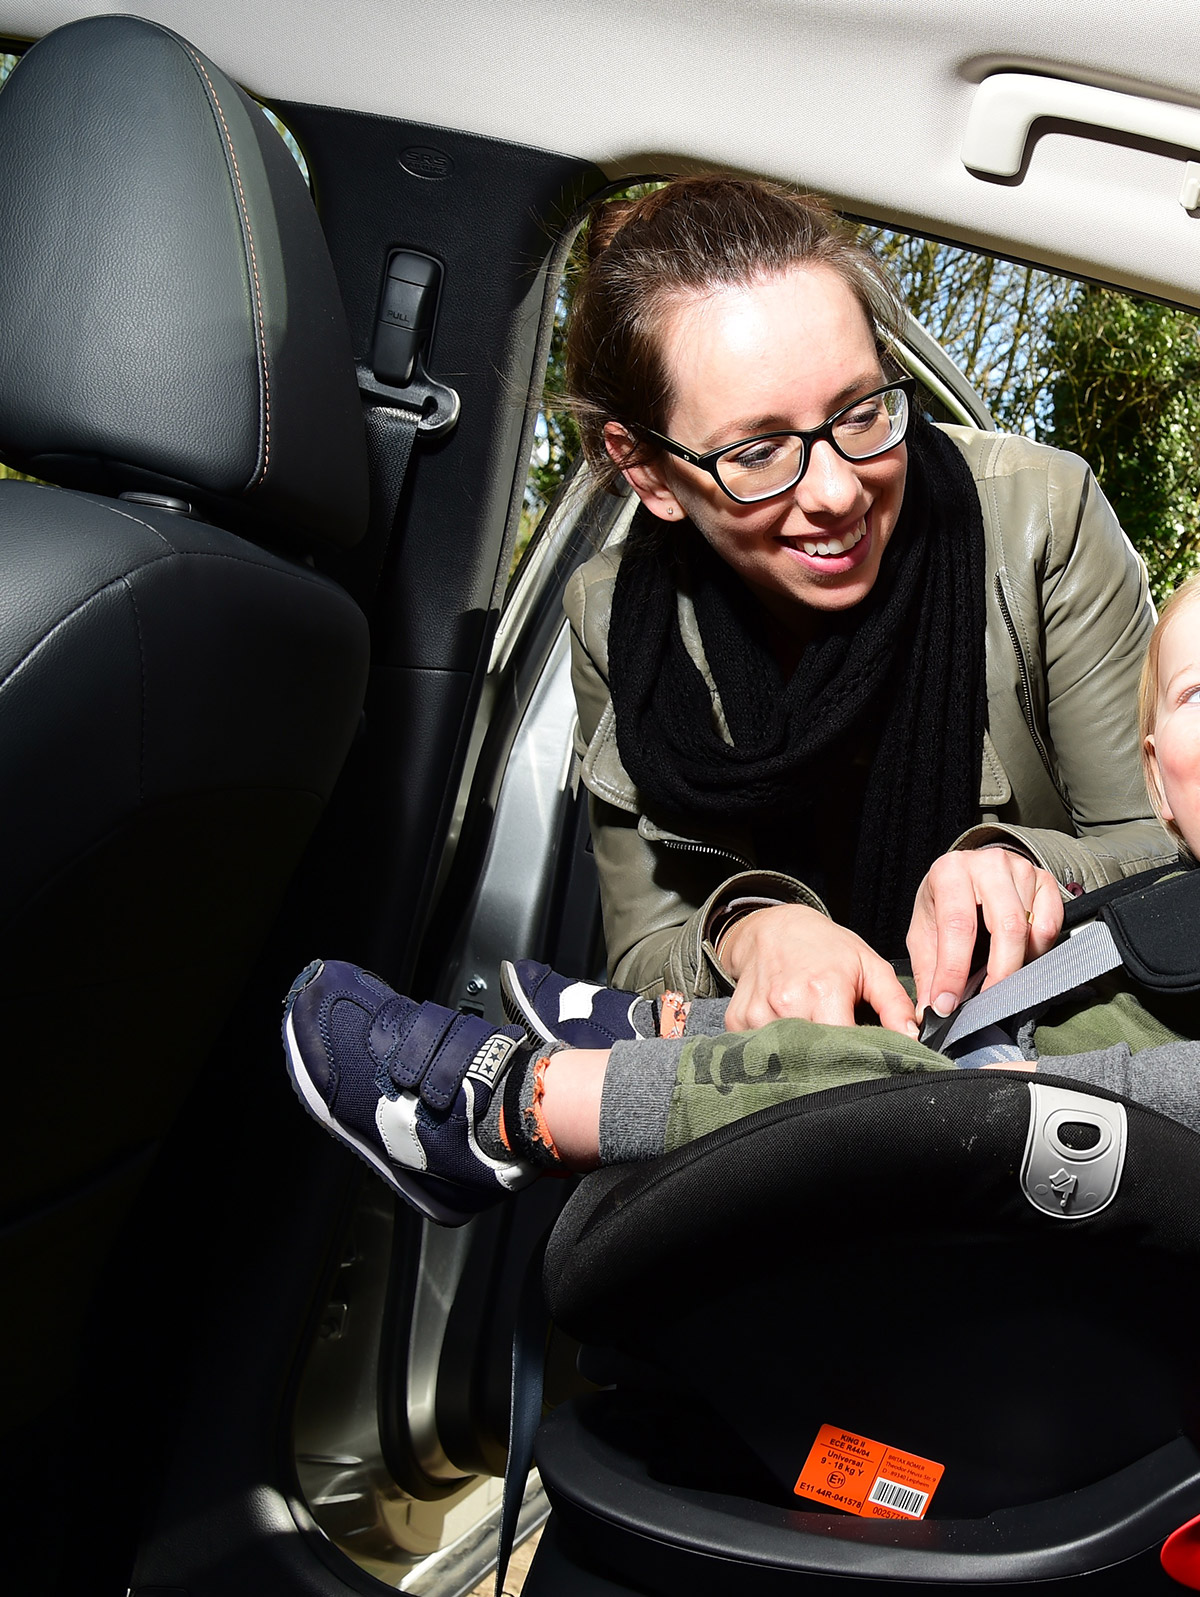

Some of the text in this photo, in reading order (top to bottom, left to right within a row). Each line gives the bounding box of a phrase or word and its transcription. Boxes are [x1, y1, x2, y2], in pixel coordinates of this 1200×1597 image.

[406, 151, 447, 166] SRS
[387, 309, 409, 323] PULL
[829, 1438, 870, 1457] ECE R44/04
[840, 1434, 860, 1446] KING
[820, 1456, 827, 1464] 9
[834, 1461, 844, 1470] 18
[845, 1465, 856, 1476] kg
[858, 1469, 865, 1477] Y
[827, 1449, 864, 1468] Universal
[799, 1481, 862, 1509] E11 44R-041578
